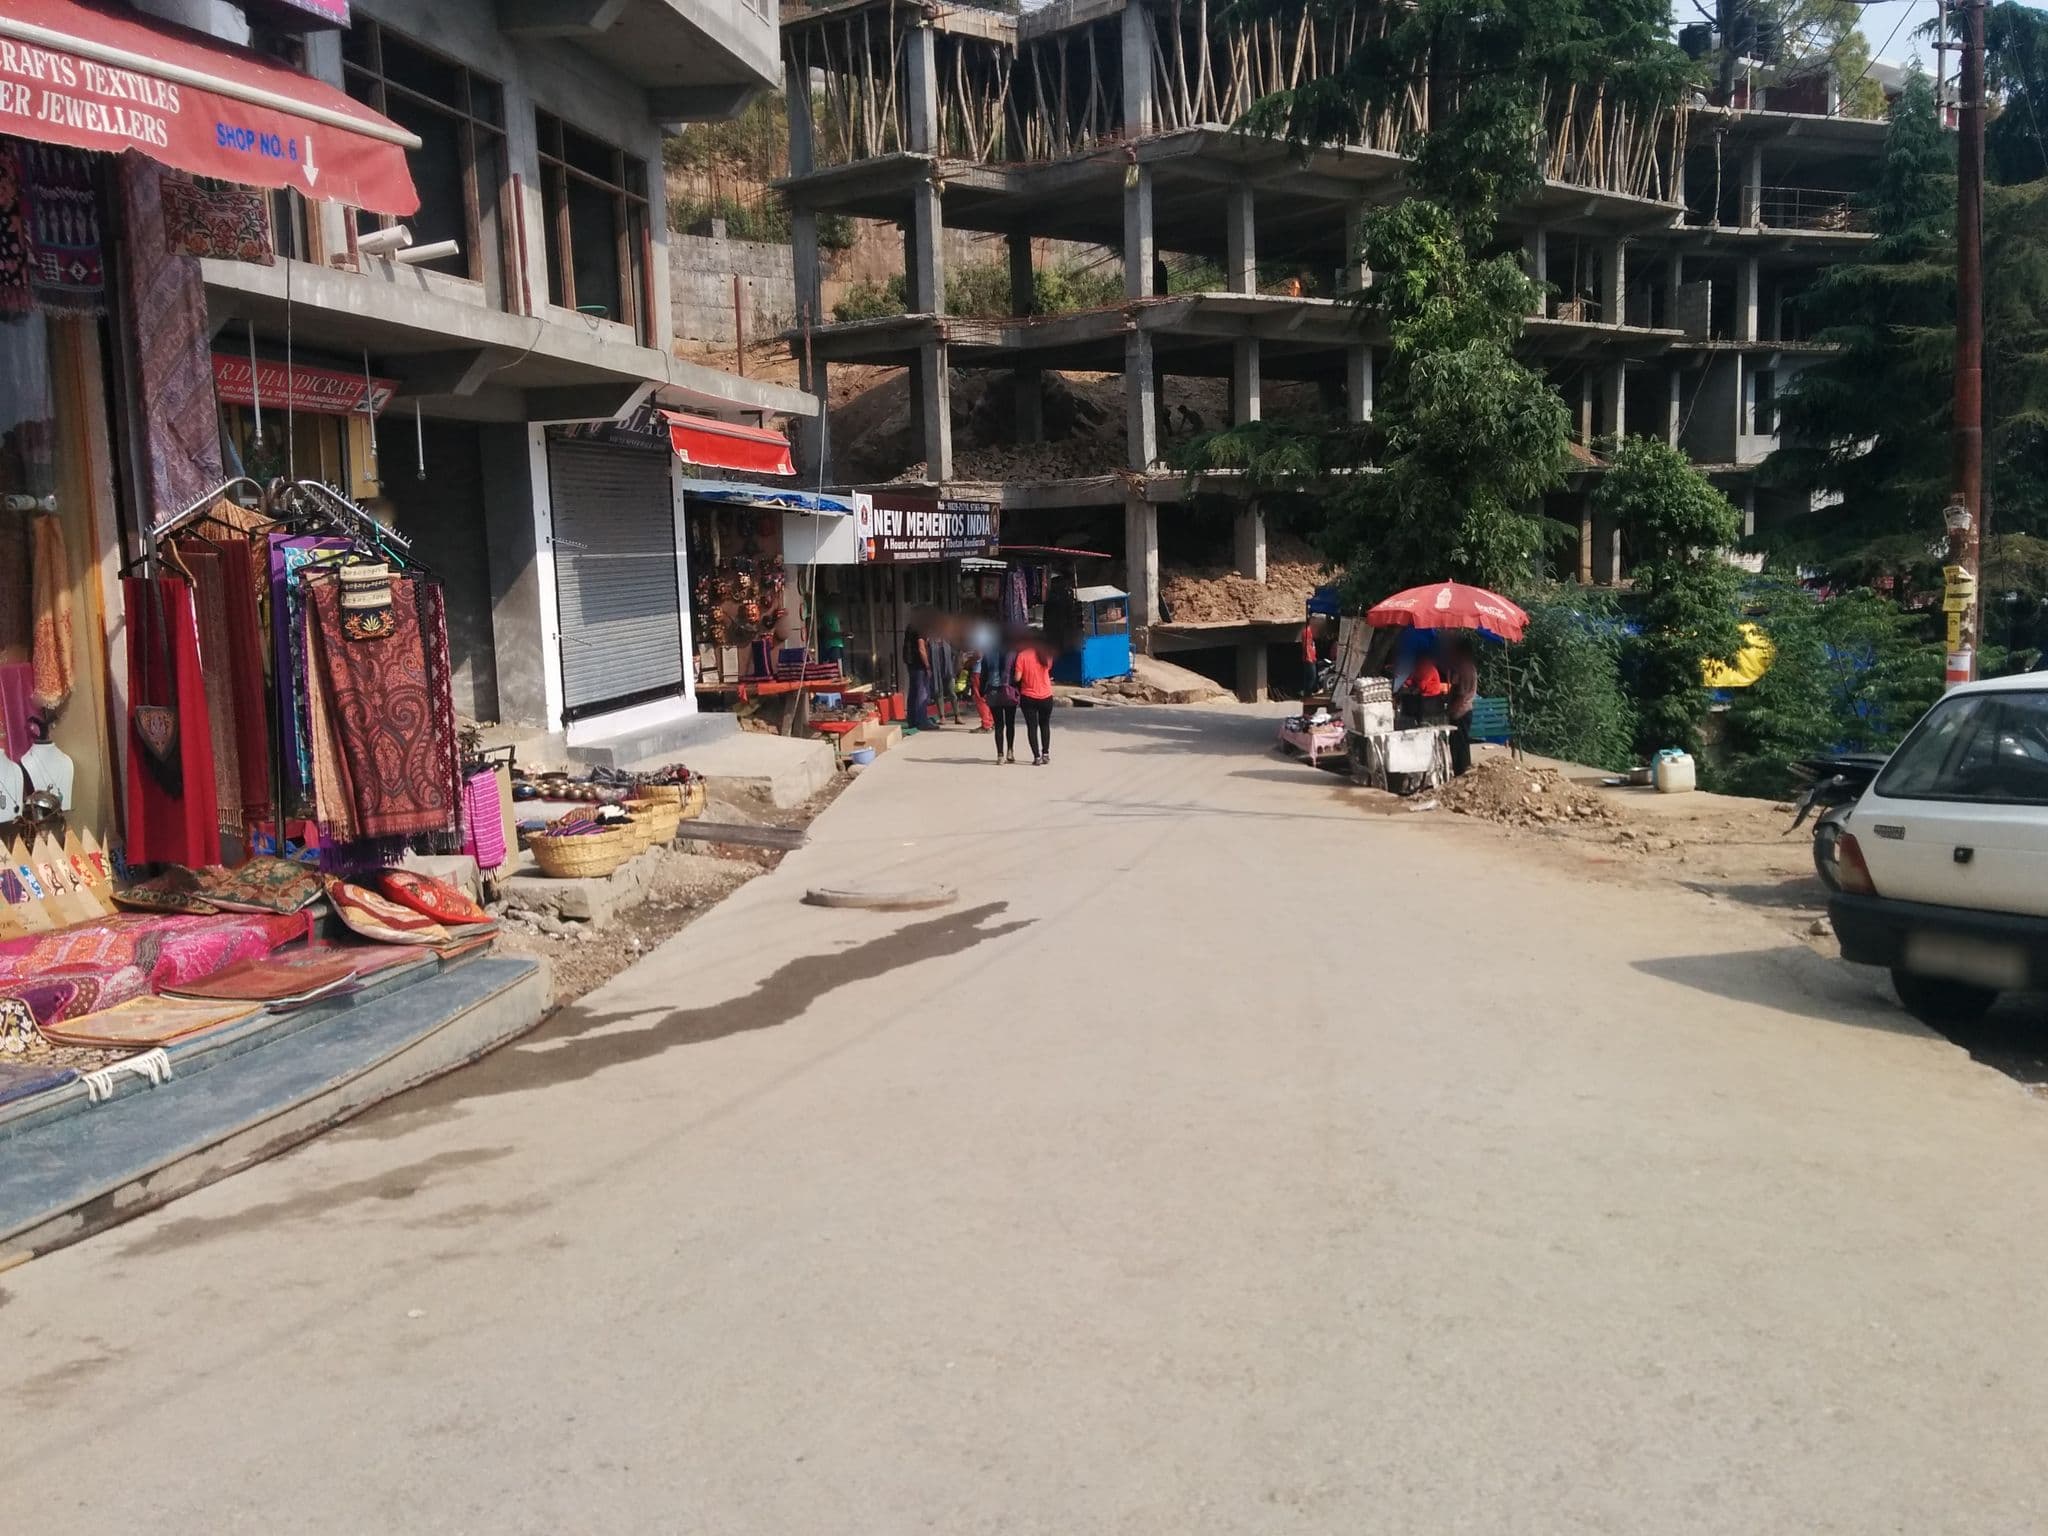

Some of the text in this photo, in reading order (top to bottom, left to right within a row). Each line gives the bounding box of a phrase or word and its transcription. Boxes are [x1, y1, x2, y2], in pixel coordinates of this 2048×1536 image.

[0, 40, 180, 114] RAFTS TEXTILES
[37, 90, 168, 147] JEWELLERS
[216, 122, 297, 160] SHOP NO. 6
[874, 509, 990, 536] NEW MEMENTOS INDIA
[890, 538, 908, 550] House
[909, 537, 915, 550] of
[917, 538, 939, 552] Antiques
